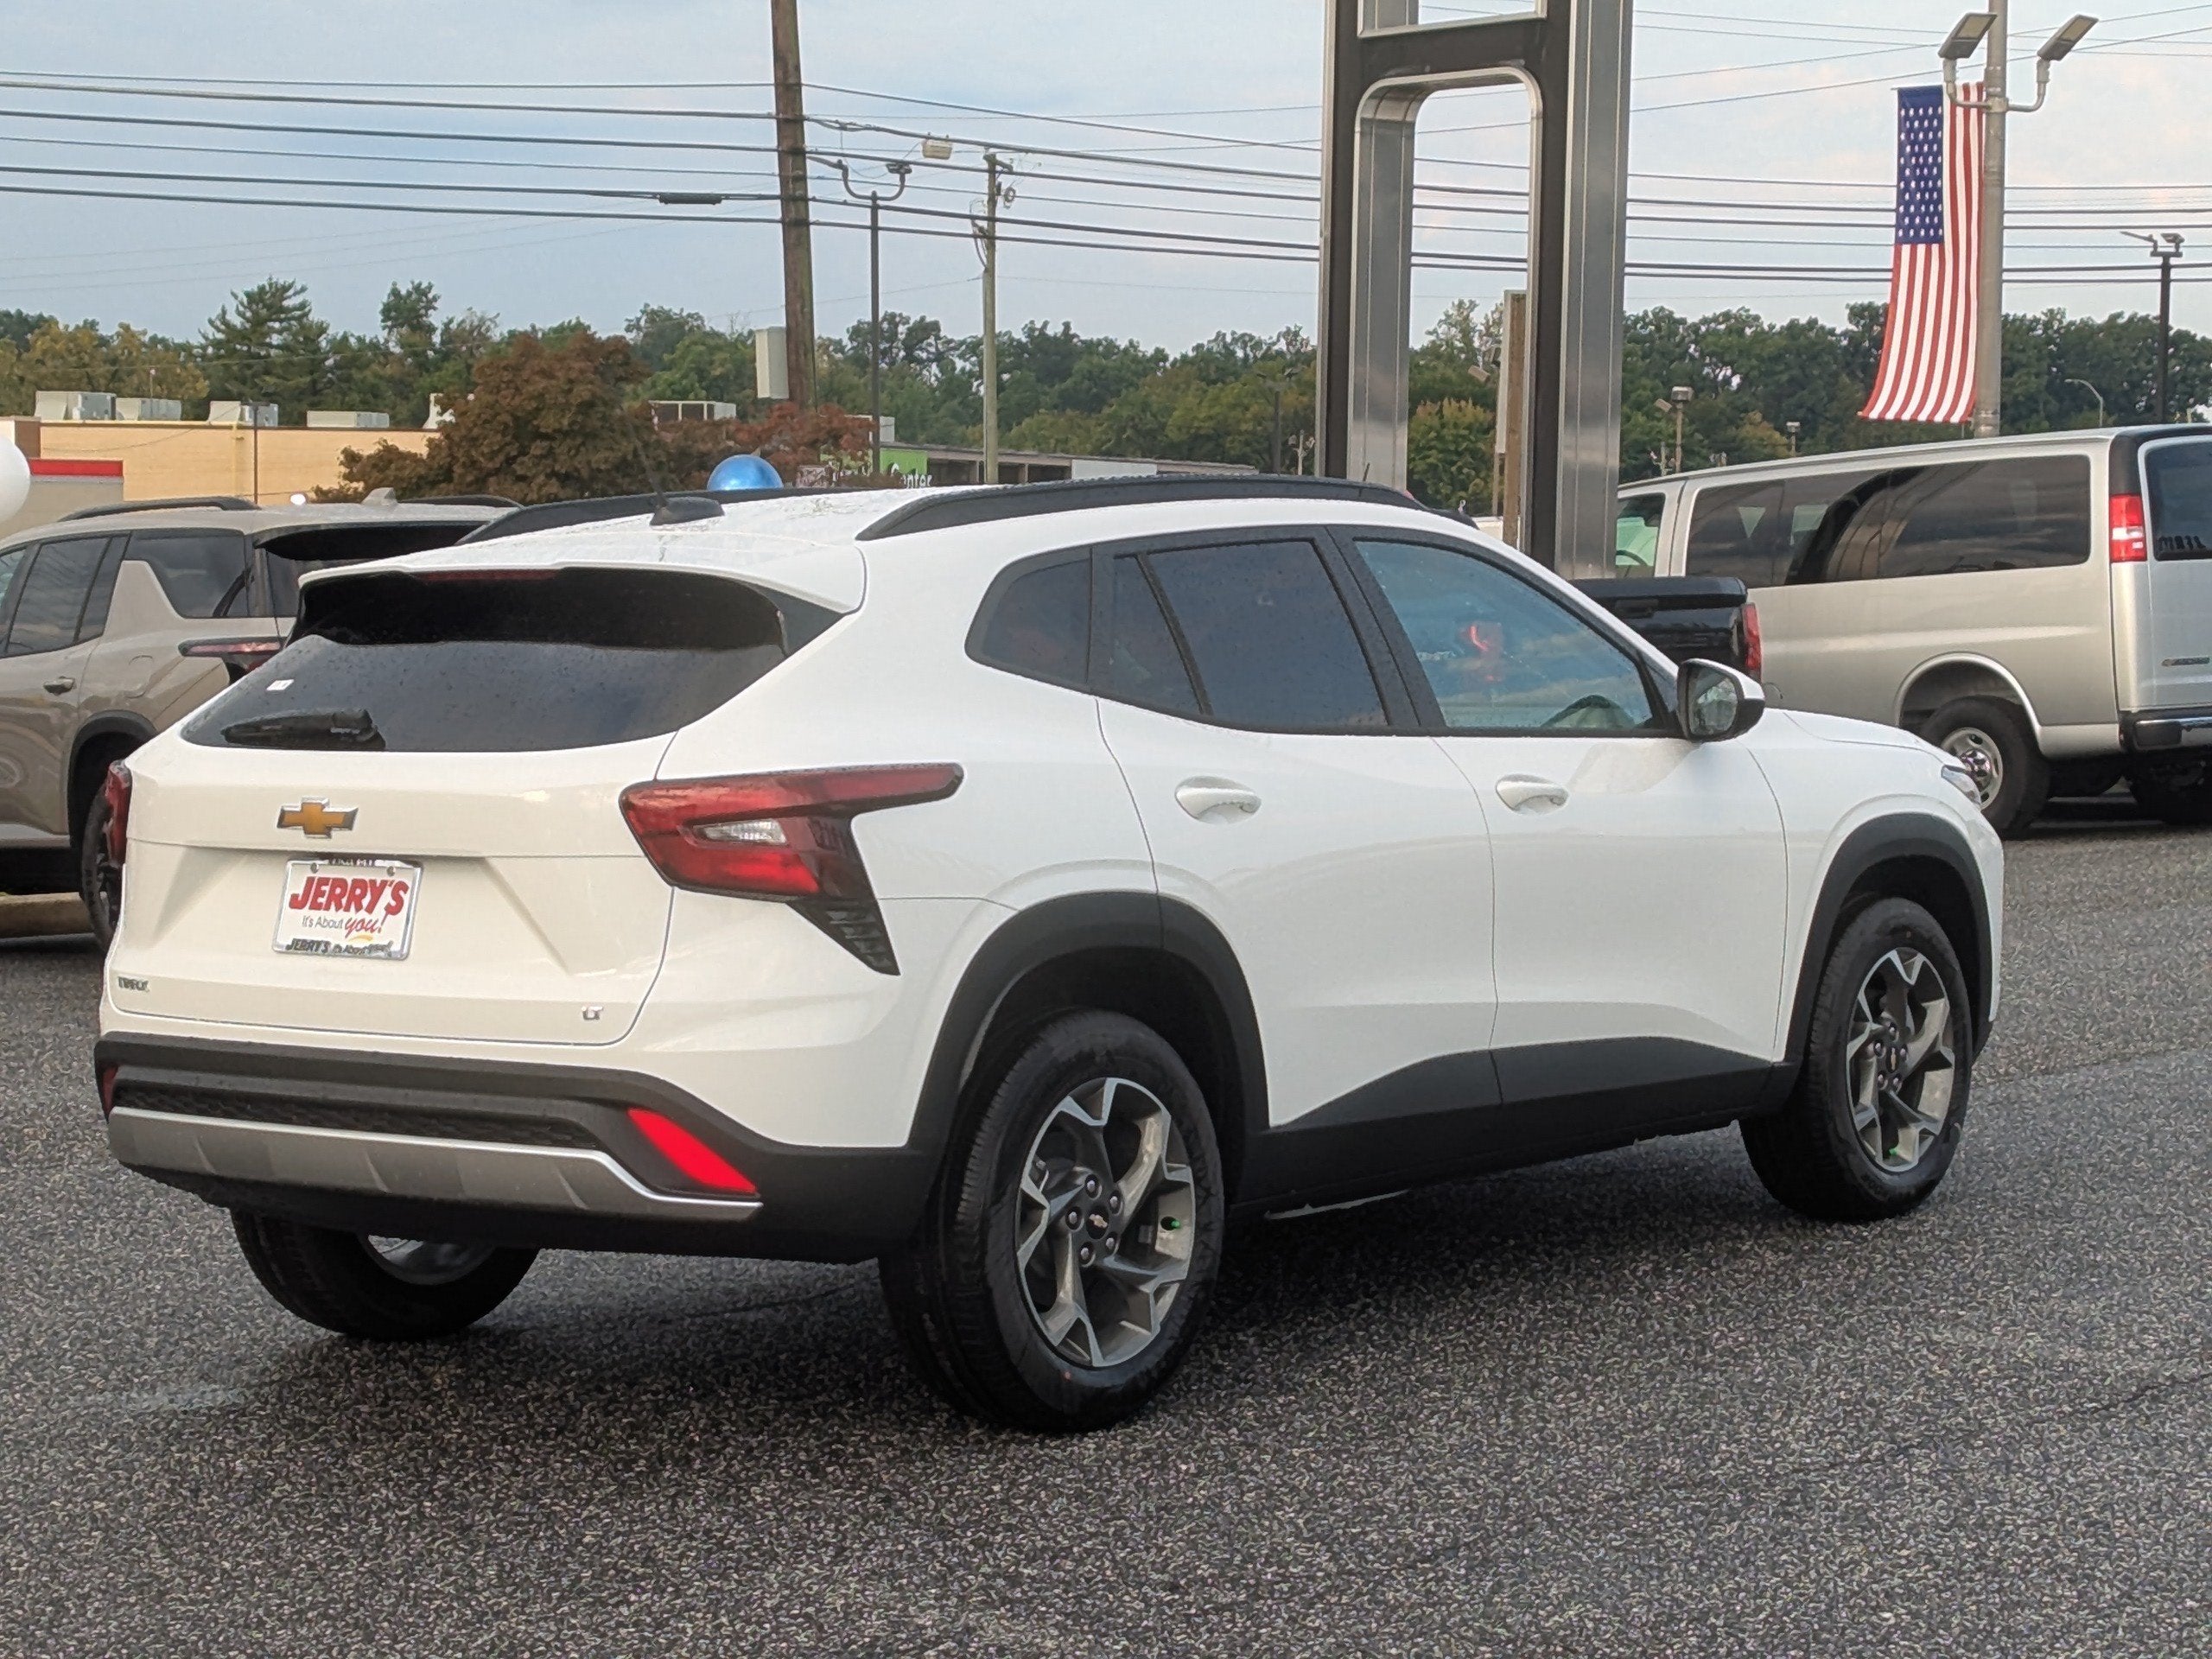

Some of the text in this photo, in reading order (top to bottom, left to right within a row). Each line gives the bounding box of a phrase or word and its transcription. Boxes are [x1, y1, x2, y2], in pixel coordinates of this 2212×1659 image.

[289, 875, 410, 916] JERRY'S
[302, 912, 389, 938] It's About you!
